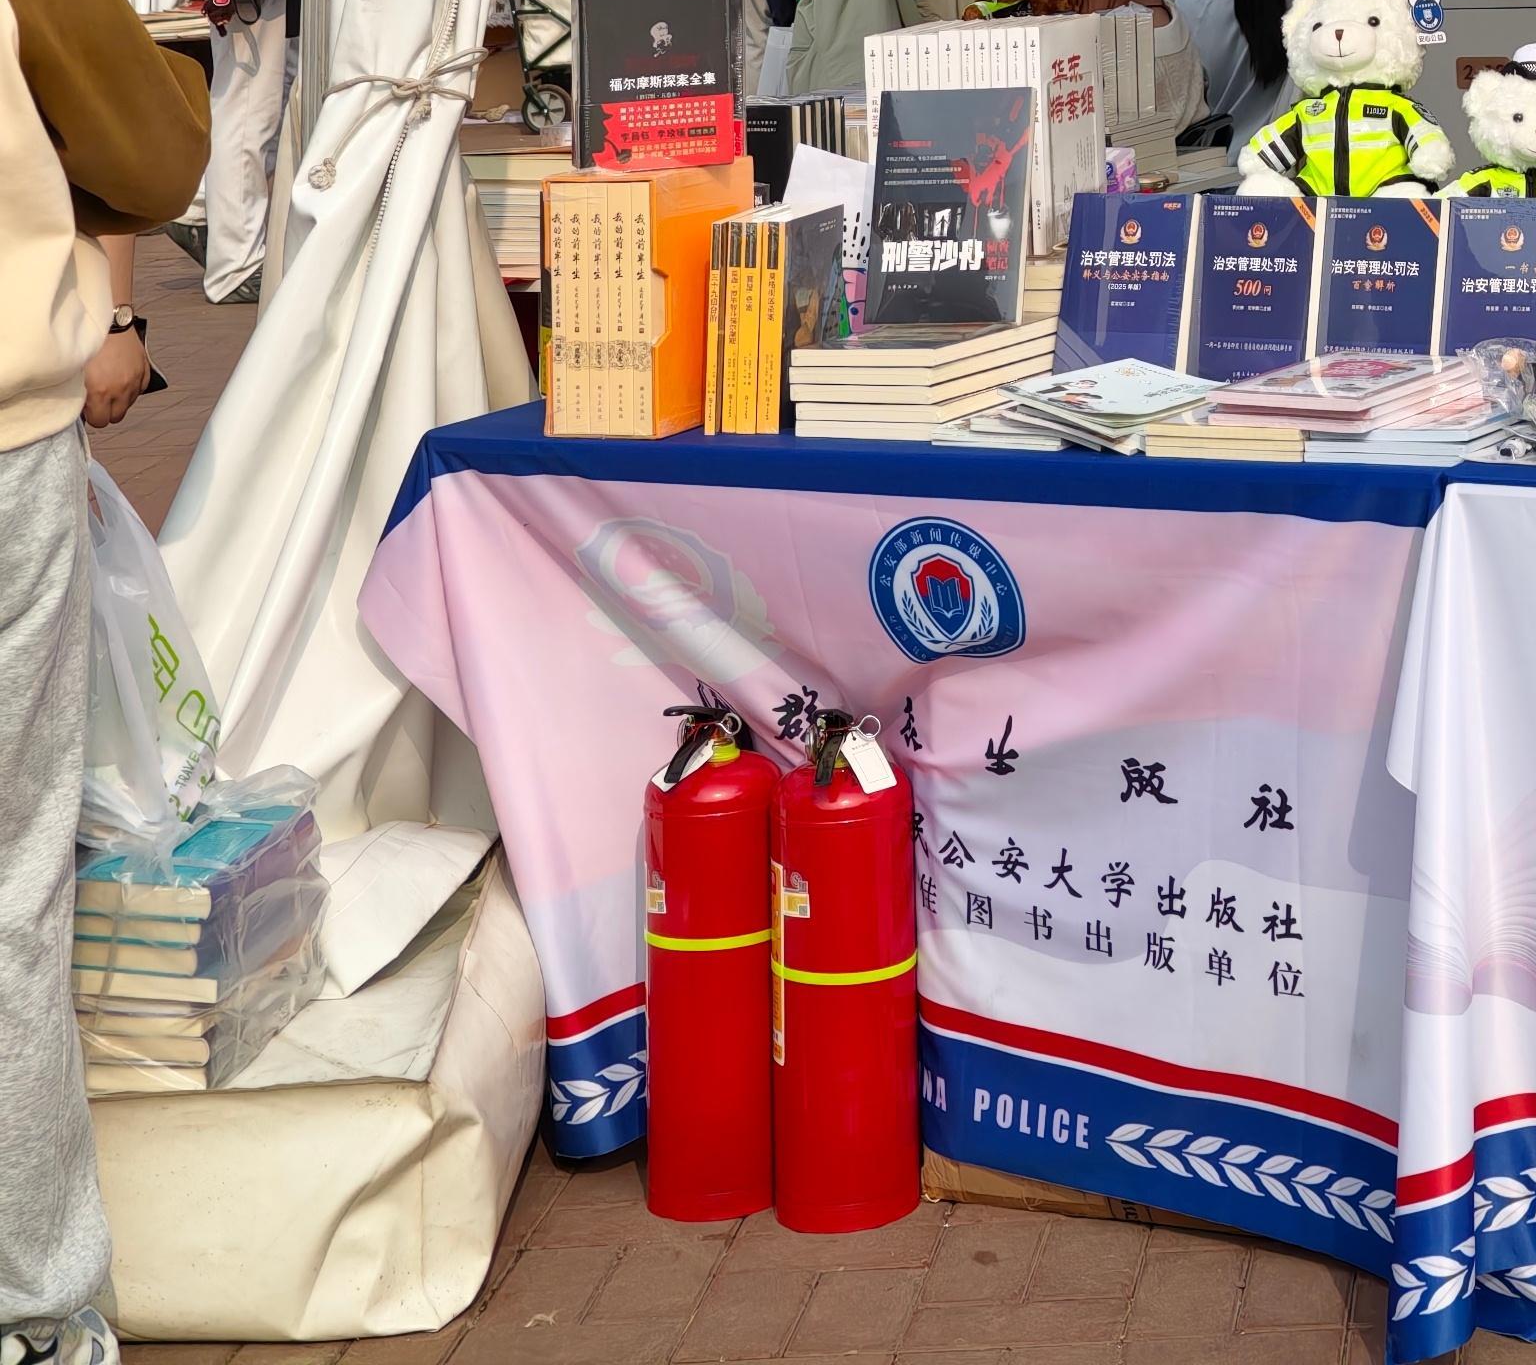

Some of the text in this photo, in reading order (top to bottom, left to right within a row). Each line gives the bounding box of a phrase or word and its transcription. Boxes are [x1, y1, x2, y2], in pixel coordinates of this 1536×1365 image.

[609, 72, 716, 92] 福尔摩斯探案全集
[1050, 85, 1095, 125] 特案组
[1080, 250, 1177, 268] 治安管理处罚法
[1213, 256, 1298, 274] 治安管理处罚法
[1331, 259, 1420, 277] 治安管理处罚法
[1082, 269, 1170, 282] 释义与公安实务指南
[973, 1087, 1090, 1150] POLICE
